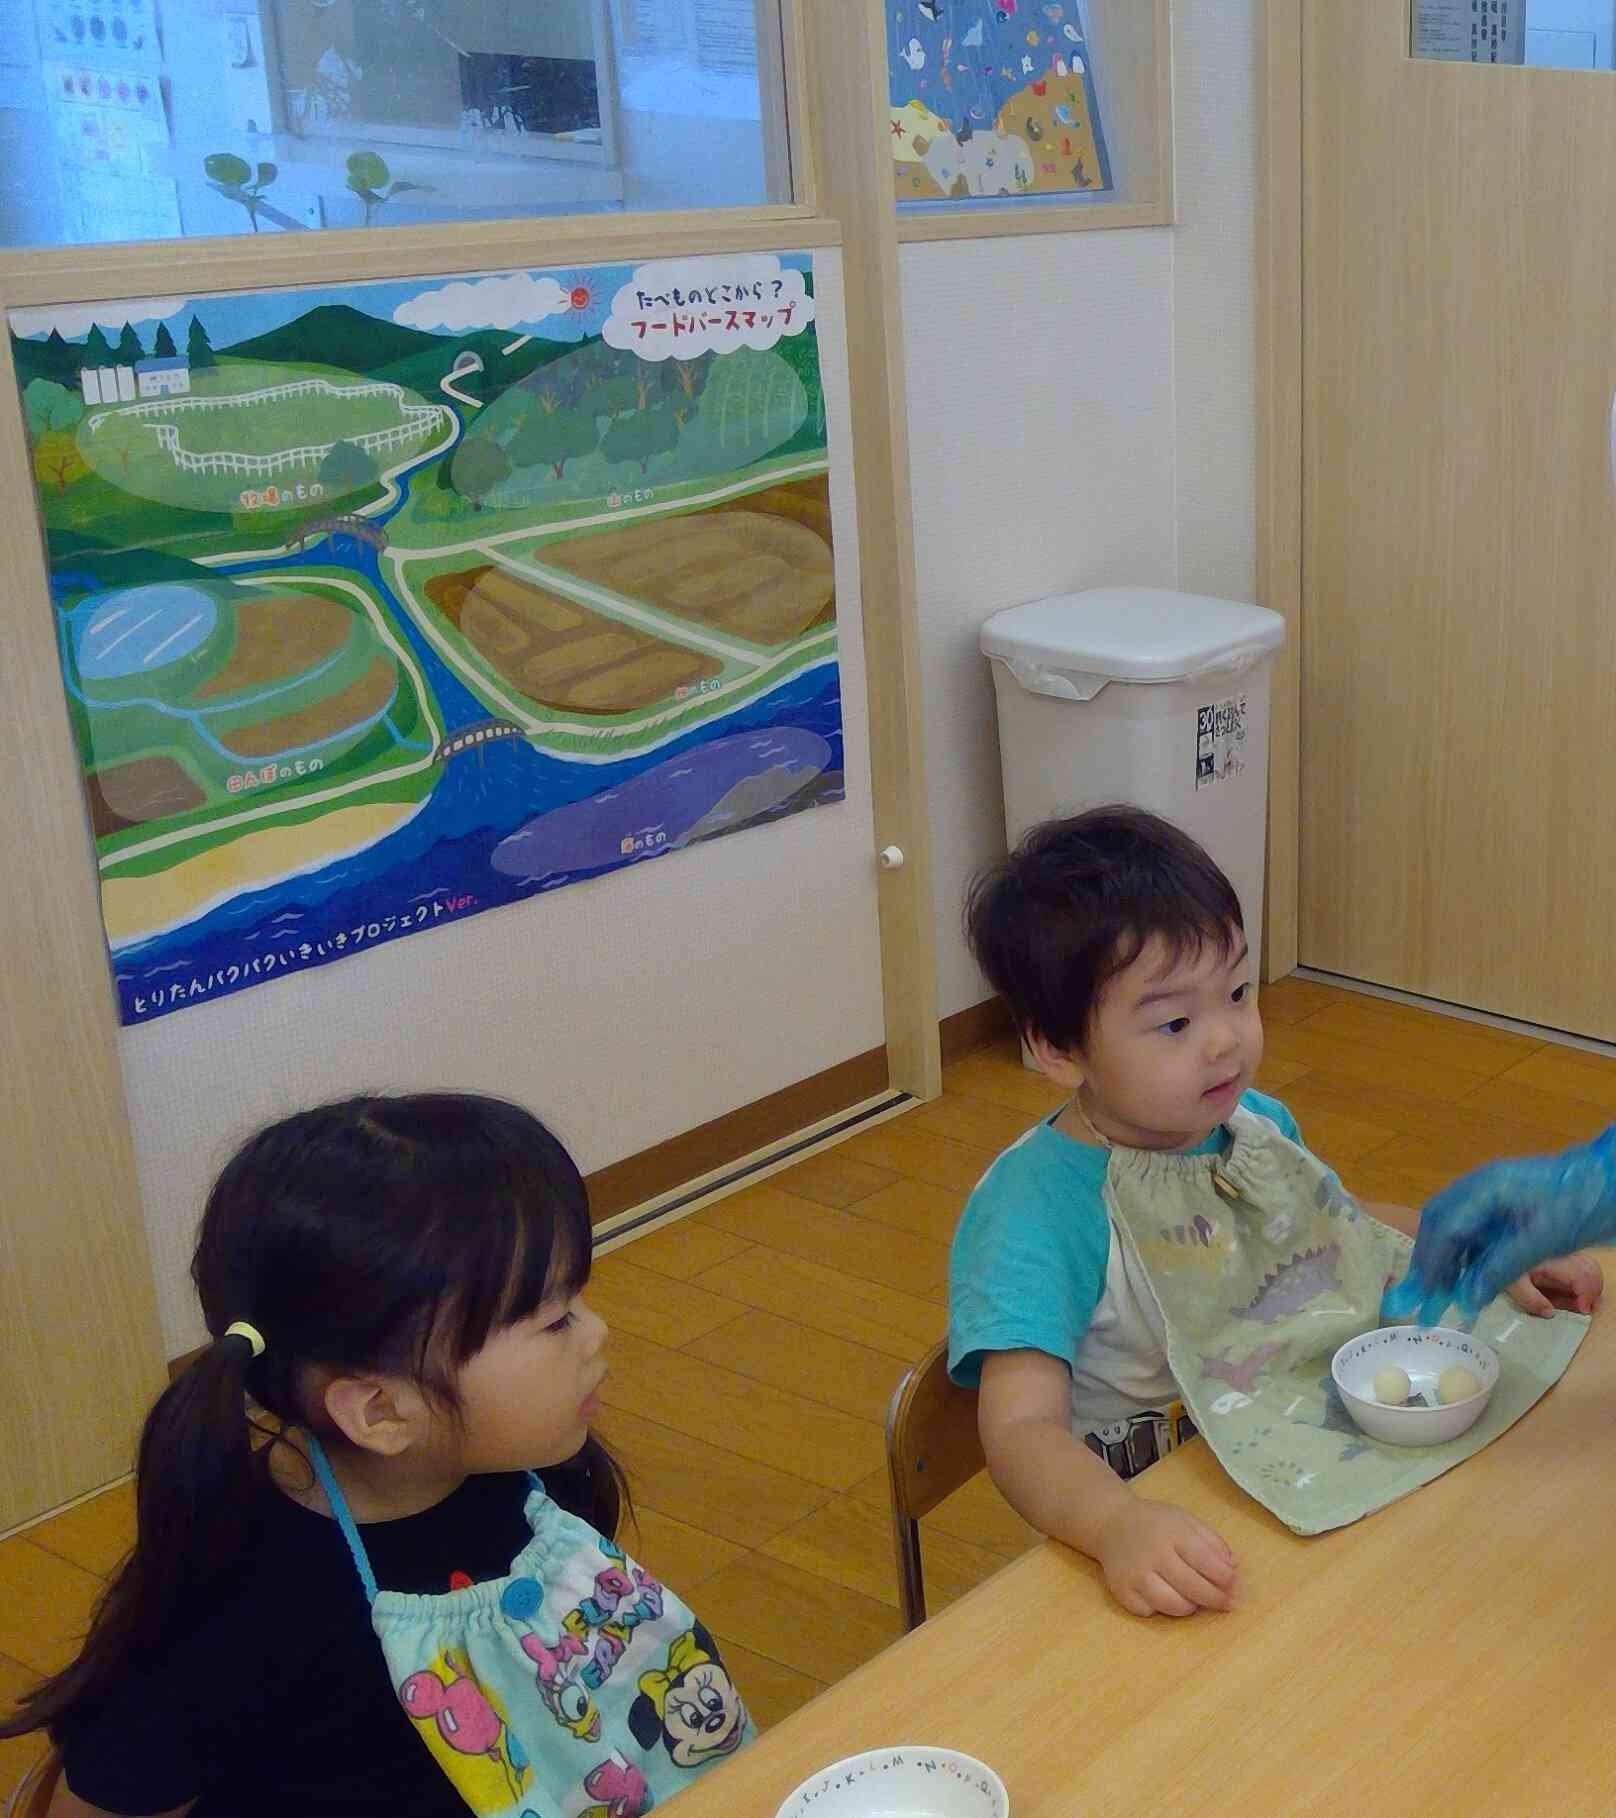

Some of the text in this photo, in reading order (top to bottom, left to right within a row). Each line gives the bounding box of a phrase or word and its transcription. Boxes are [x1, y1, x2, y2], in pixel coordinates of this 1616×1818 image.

[631, 300, 797, 338] フードバースマップ
